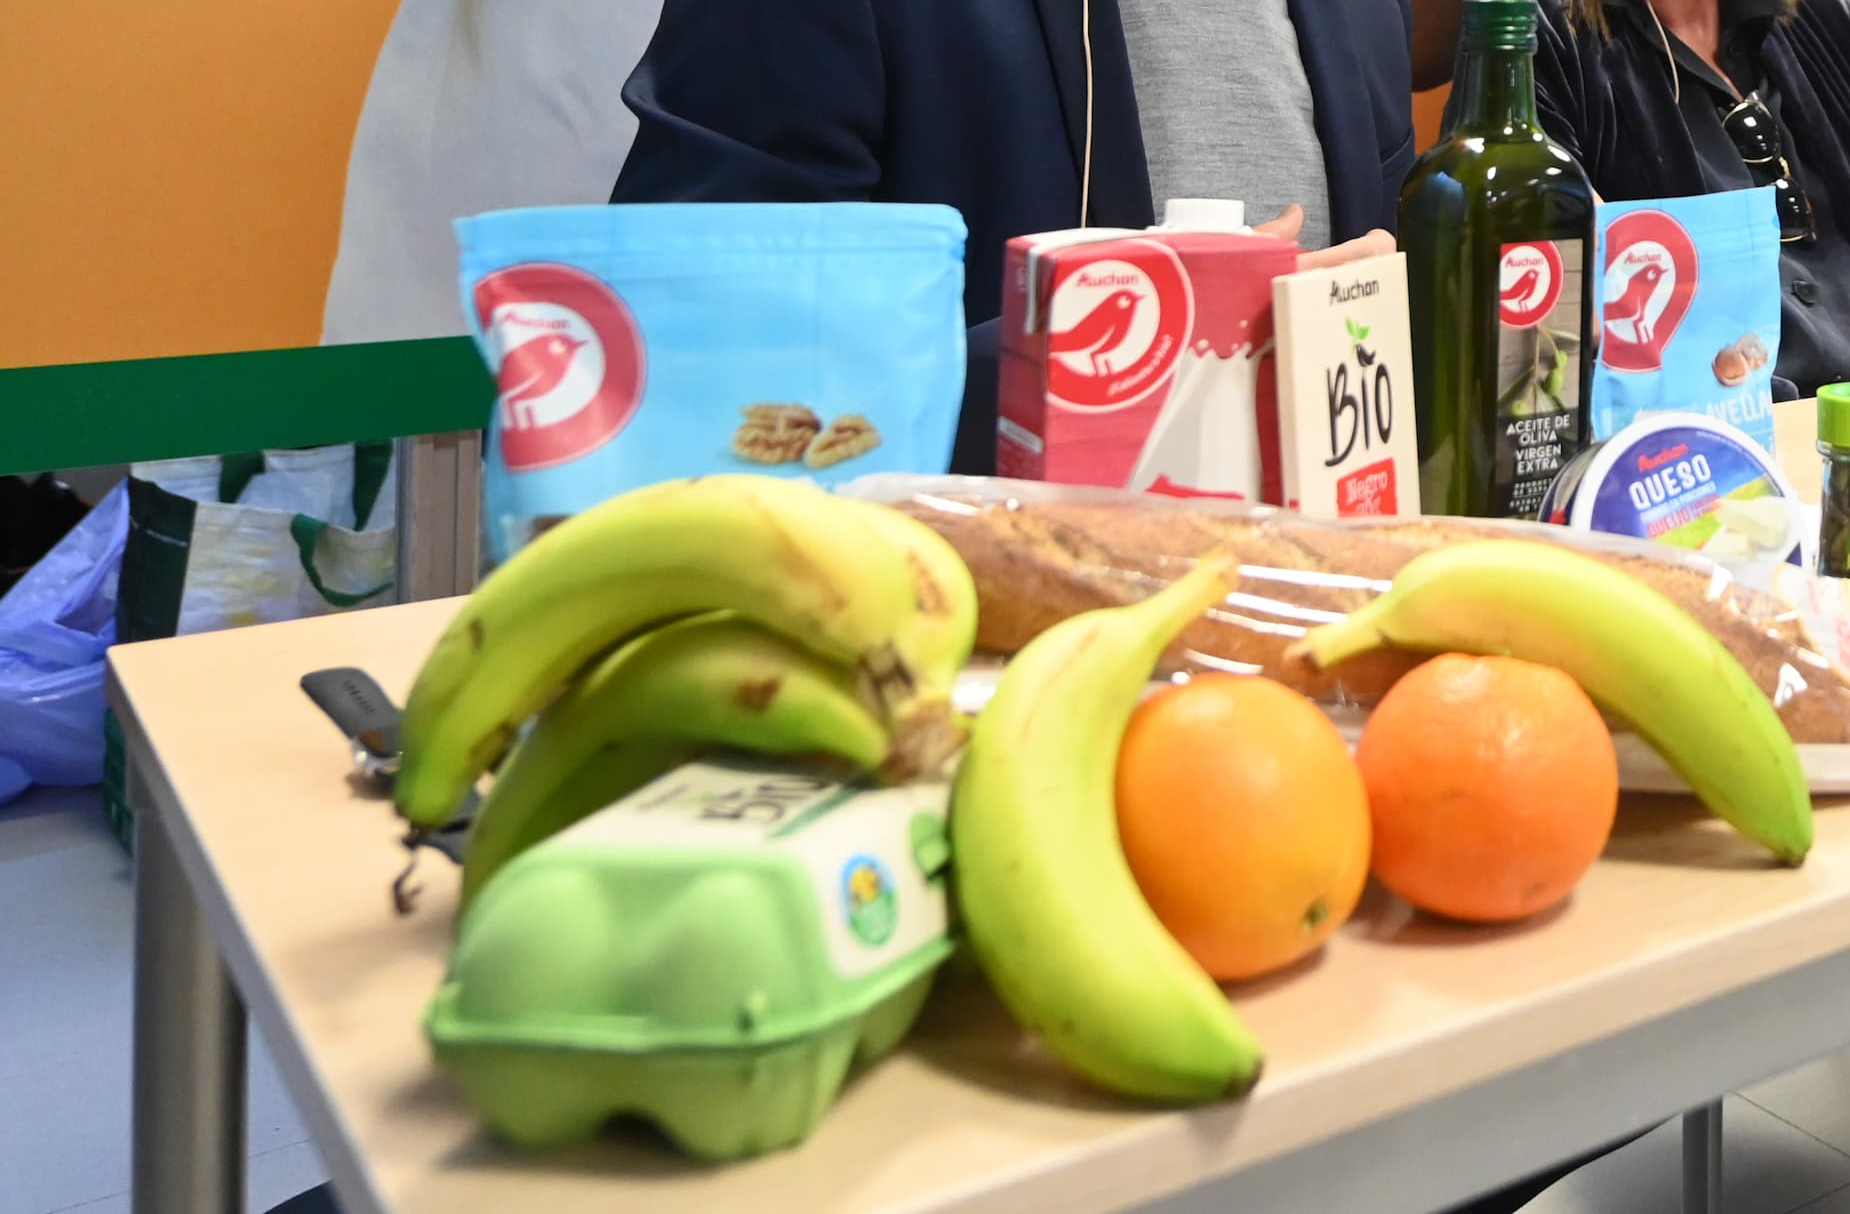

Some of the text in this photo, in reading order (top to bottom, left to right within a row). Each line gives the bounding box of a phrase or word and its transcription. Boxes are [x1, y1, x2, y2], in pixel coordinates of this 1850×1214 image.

[1504, 255, 1545, 268] Auchan
[1623, 249, 1662, 265] Auchan
[1077, 272, 1140, 287] Auchan
[1329, 279, 1381, 305] Auchan
[1506, 414, 1571, 435] ACEITE DE
[1520, 430, 1558, 446] OLIVA
[1514, 444, 1562, 461] VIRGEN
[1517, 457, 1559, 474] EXTRA
[1628, 453, 1712, 512] QUESO
